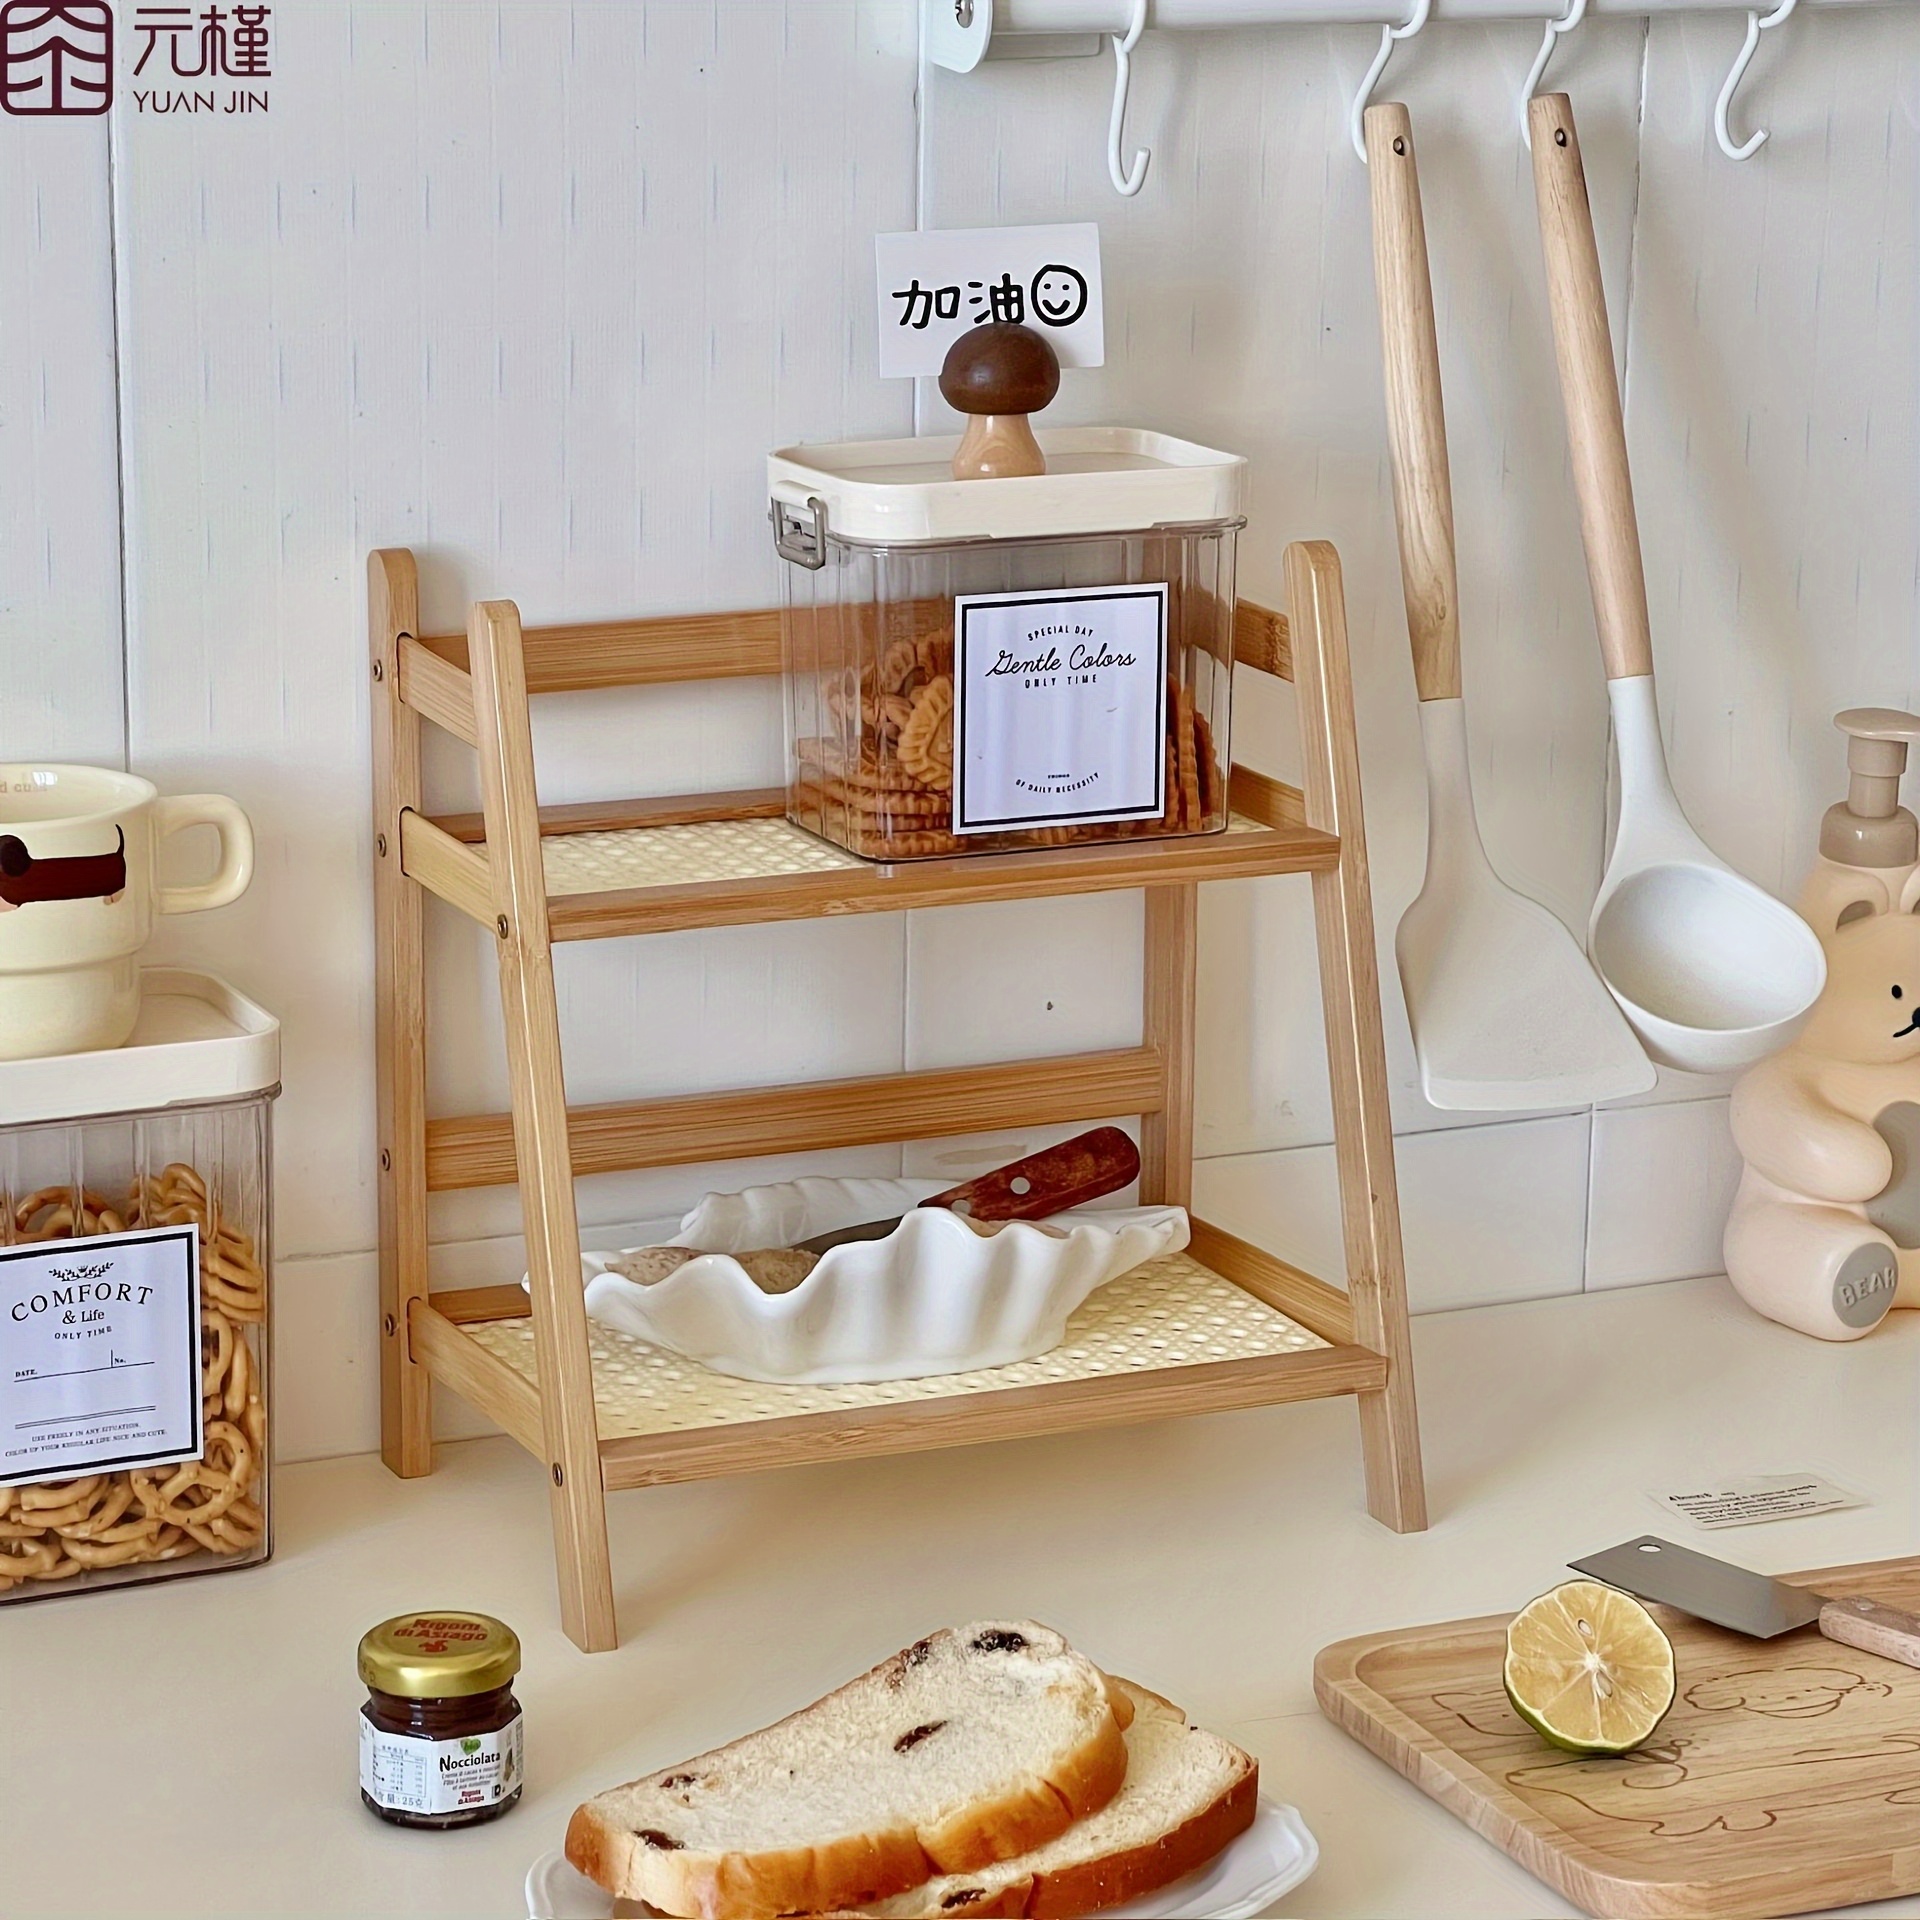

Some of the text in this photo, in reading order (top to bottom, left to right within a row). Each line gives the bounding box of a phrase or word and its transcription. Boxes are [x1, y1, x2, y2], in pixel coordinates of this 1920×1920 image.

[892, 273, 1025, 329] 加油
[1027, 625, 1094, 641] SPECIAL DAY
[985, 642, 1136, 677] Gentle Colors
[1024, 674, 1097, 689] ONLY TIME
[1028, 784, 1051, 793] DAILY
[1839, 1266, 1895, 1309] BEAR
[11, 1282, 153, 1322] COMFORT
[62, 1309, 105, 1325] & Life
[54, 1325, 112, 1340] ONLY TIME
[439, 1751, 501, 1773] Nocciolata
